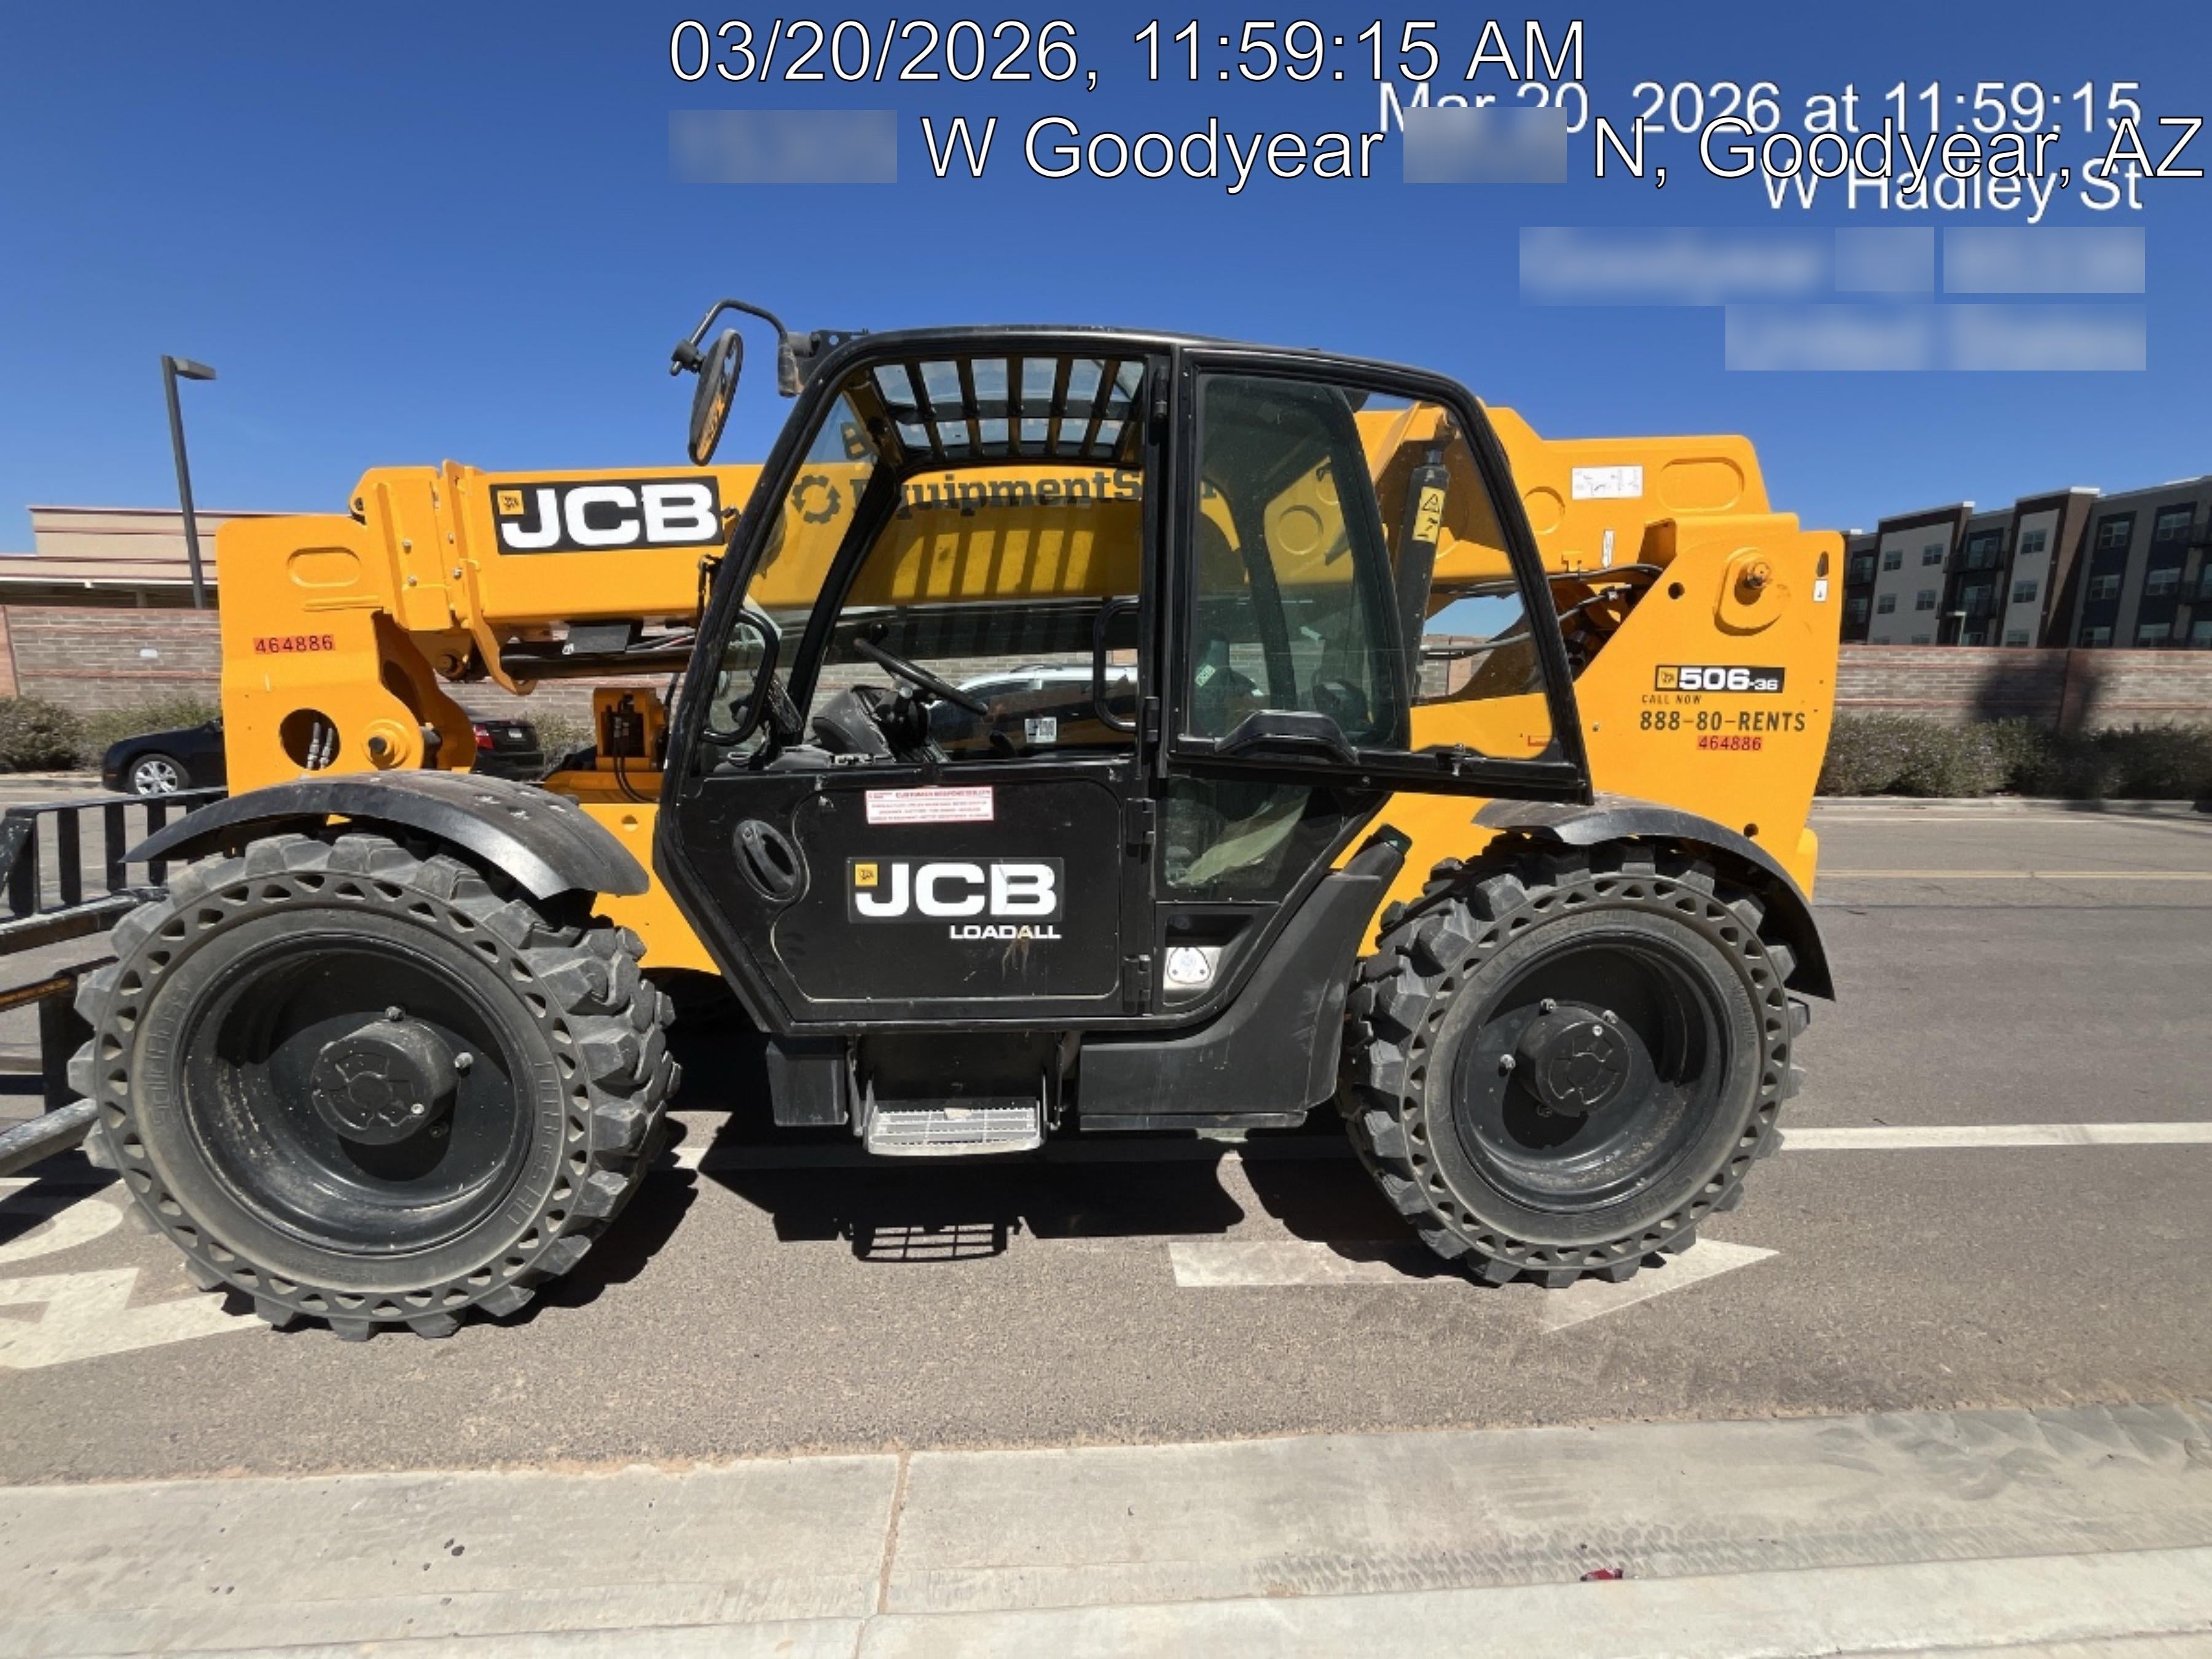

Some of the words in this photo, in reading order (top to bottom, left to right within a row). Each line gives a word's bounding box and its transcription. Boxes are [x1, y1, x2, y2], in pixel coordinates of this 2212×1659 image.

[501, 483, 718, 548] JCB
[256, 635, 332, 653] 464886
[1678, 667, 1778, 690] 506-36
[1642, 695, 1670, 705] CALL
[1676, 695, 1702, 705] NOW
[1639, 710, 1806, 731] 888-80-RENTS
[1698, 735, 1762, 750] 464886
[855, 863, 1057, 917] JCB
[950, 925, 1062, 939] LOADALL
